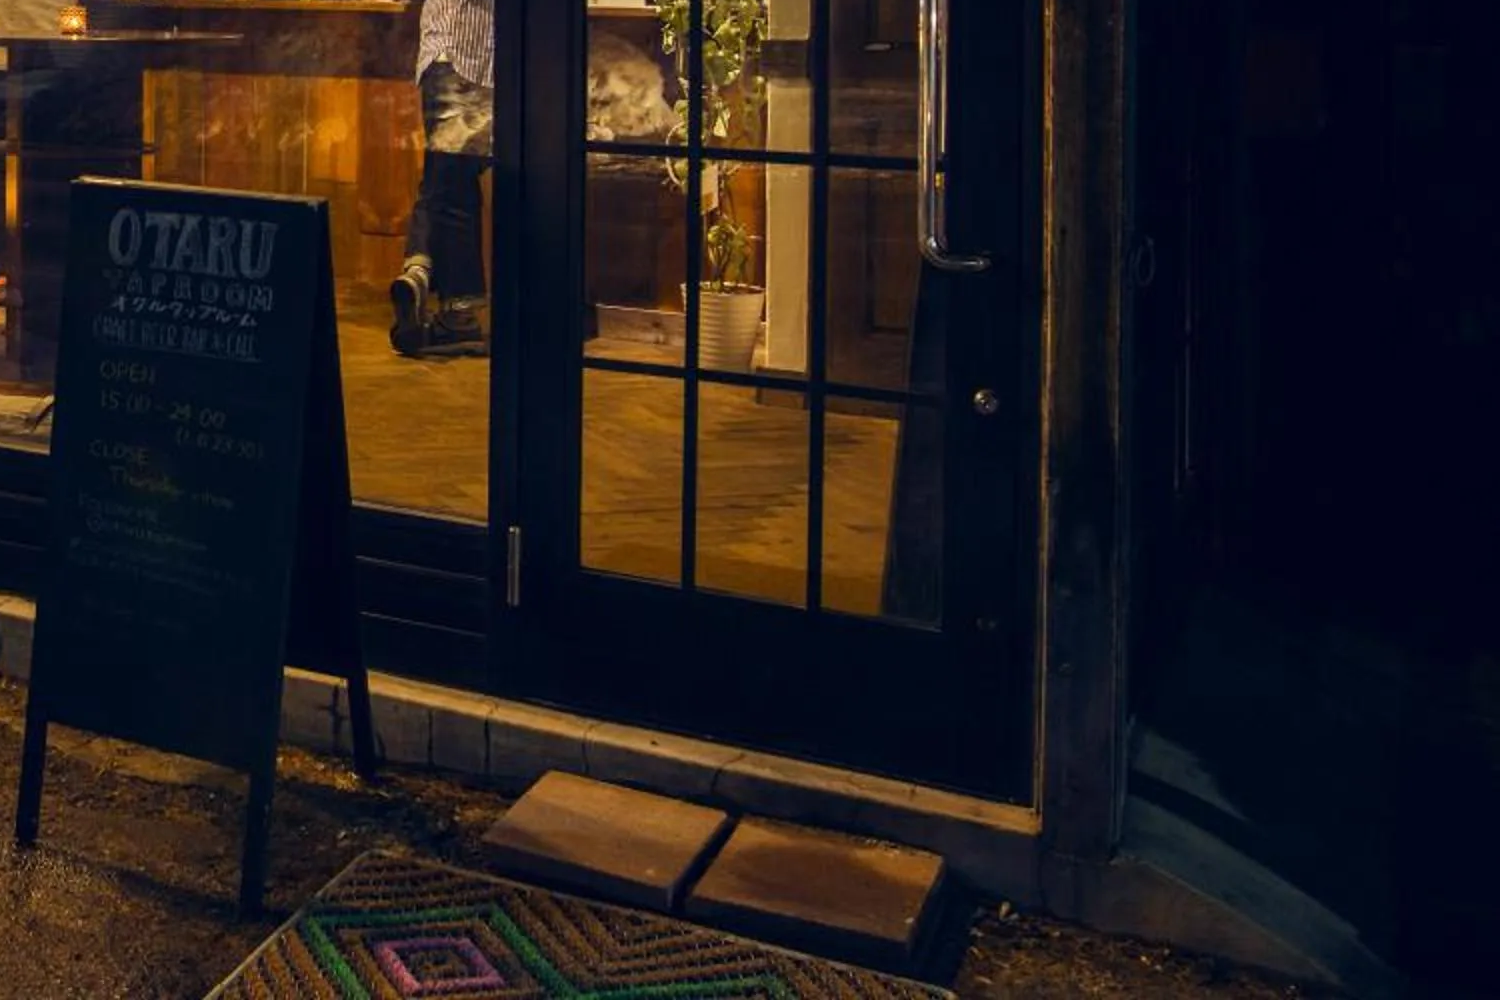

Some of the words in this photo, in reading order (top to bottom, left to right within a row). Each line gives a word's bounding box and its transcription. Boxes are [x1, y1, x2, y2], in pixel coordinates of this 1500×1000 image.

[107, 206, 280, 280] OTARU
[100, 358, 156, 385] OPEN
[86, 437, 151, 467] CLOSE
